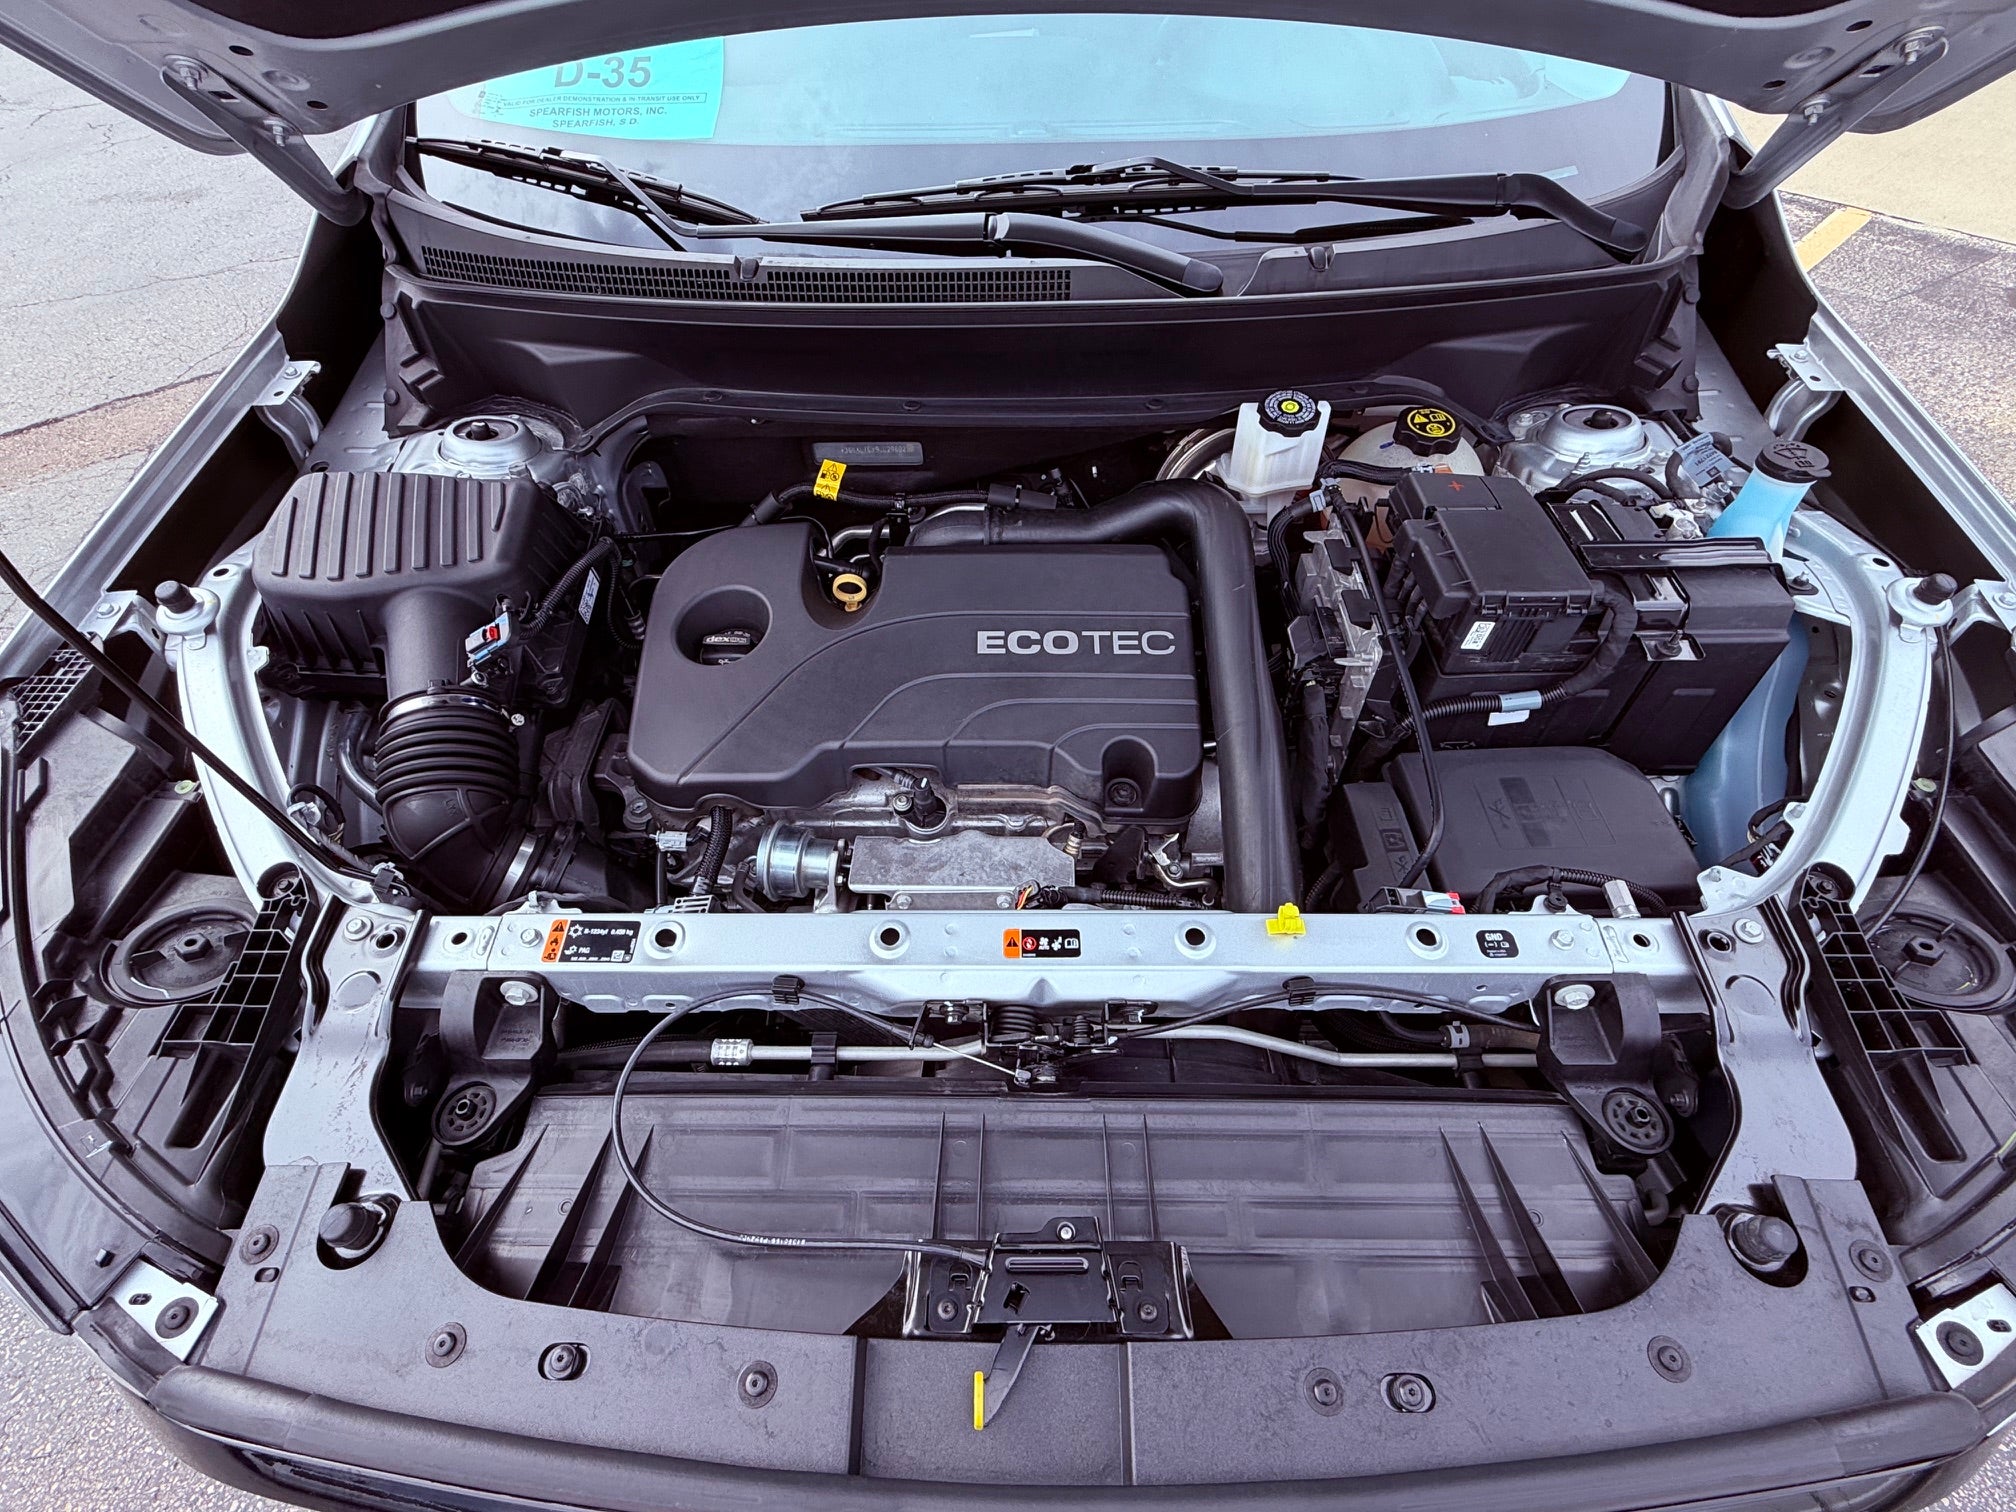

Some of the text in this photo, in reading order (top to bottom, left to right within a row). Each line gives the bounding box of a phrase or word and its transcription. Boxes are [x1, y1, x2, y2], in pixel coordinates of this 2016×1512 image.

[555, 56, 652, 88] D-35
[536, 96, 561, 104] DEALER
[529, 106, 667, 117] SPEARFISH MOTORS, INC.
[552, 118, 616, 128] SPEARFISH,
[977, 630, 1176, 655] ECOTEC
[1485, 933, 1503, 941] GND
